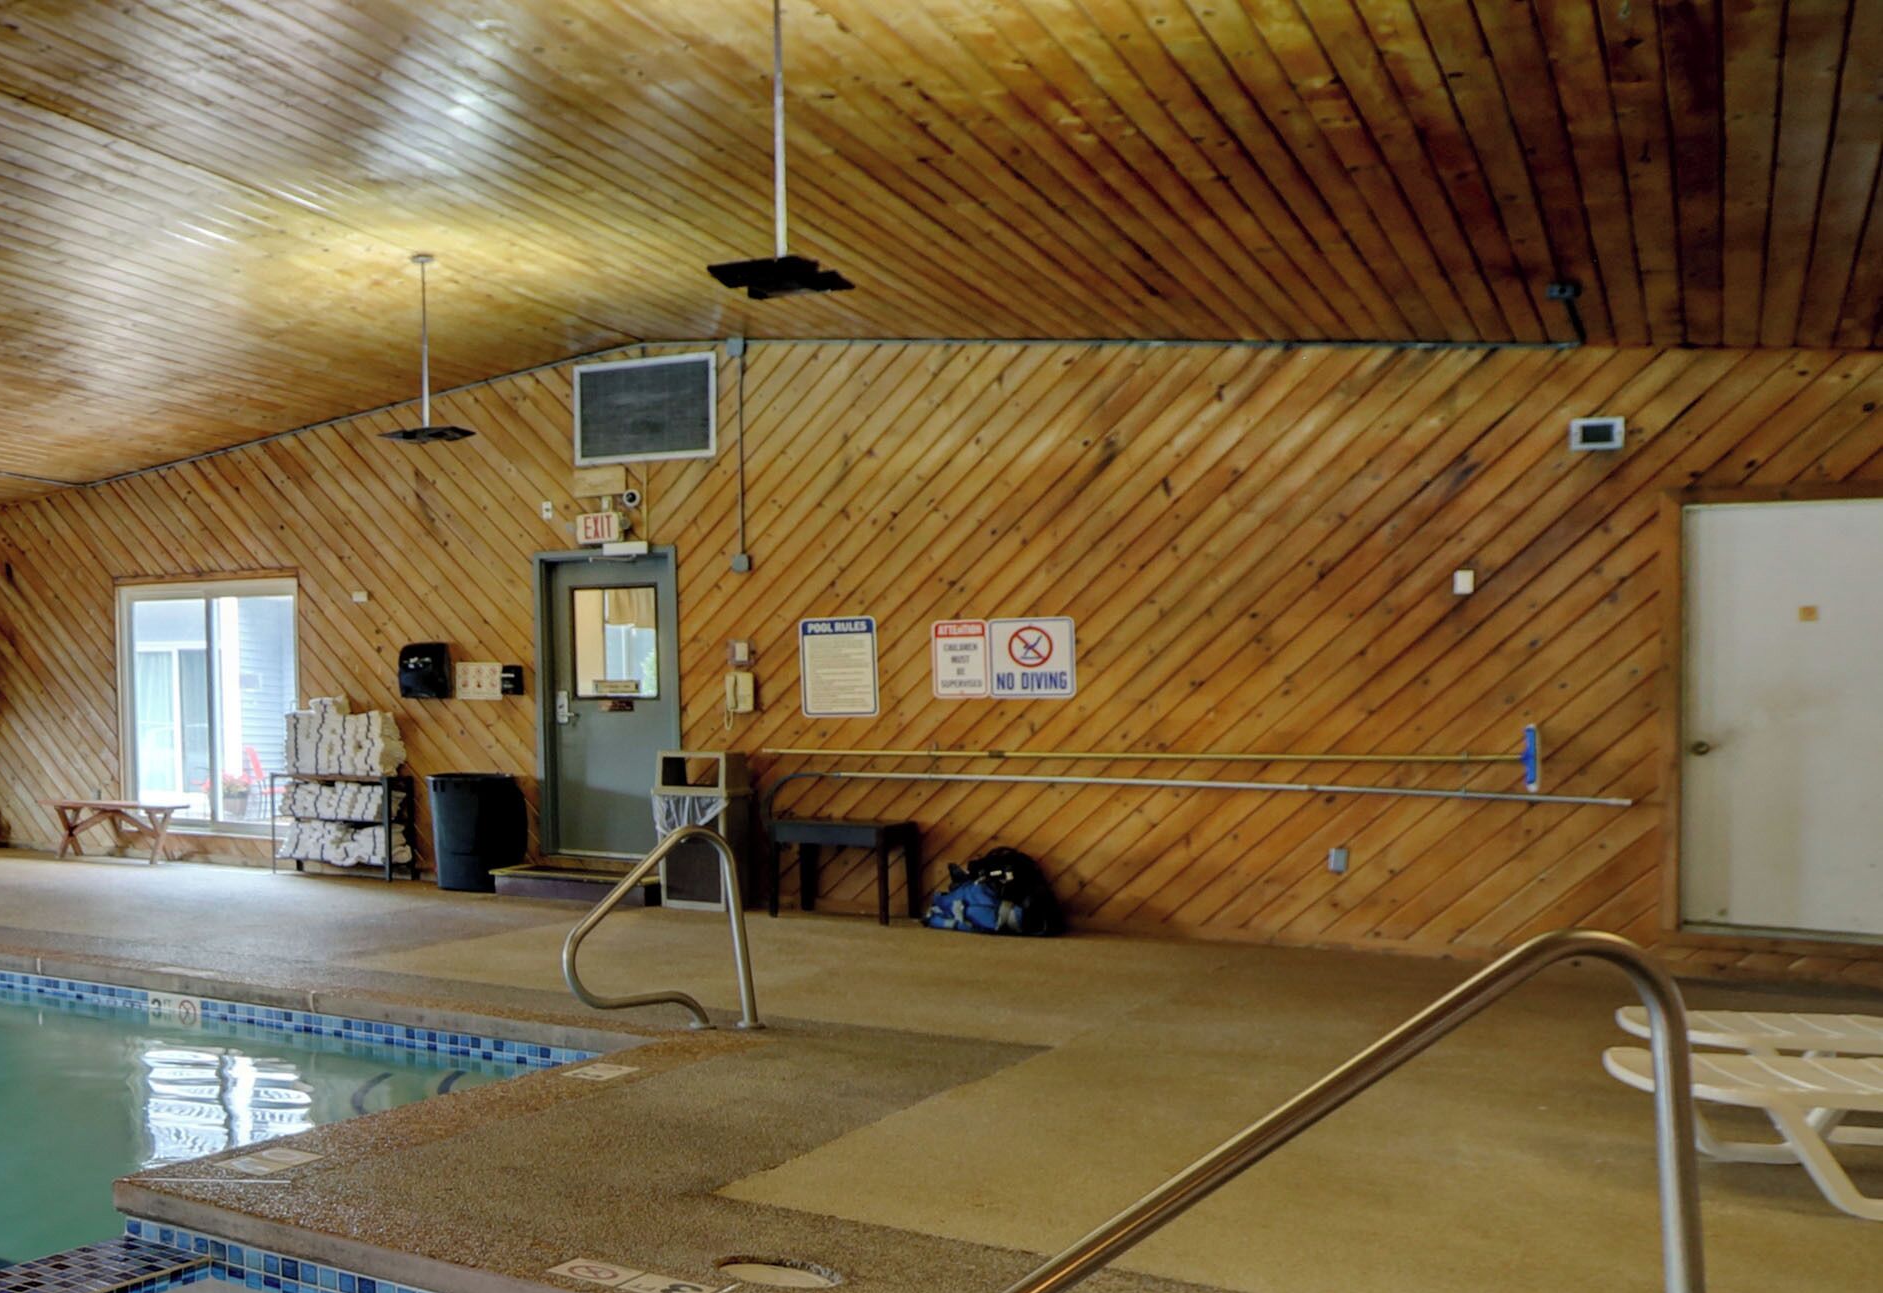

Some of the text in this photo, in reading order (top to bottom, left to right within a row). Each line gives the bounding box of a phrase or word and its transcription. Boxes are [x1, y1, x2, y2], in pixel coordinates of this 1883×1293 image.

[583, 515, 611, 539] EXIT
[807, 621, 867, 634] POOL RULES
[943, 643, 978, 652] CHILDREN
[951, 655, 970, 664] MUST
[957, 667, 966, 675] BE
[941, 679, 983, 688] SUPERVISED
[996, 671, 1067, 691] NO DIVING
